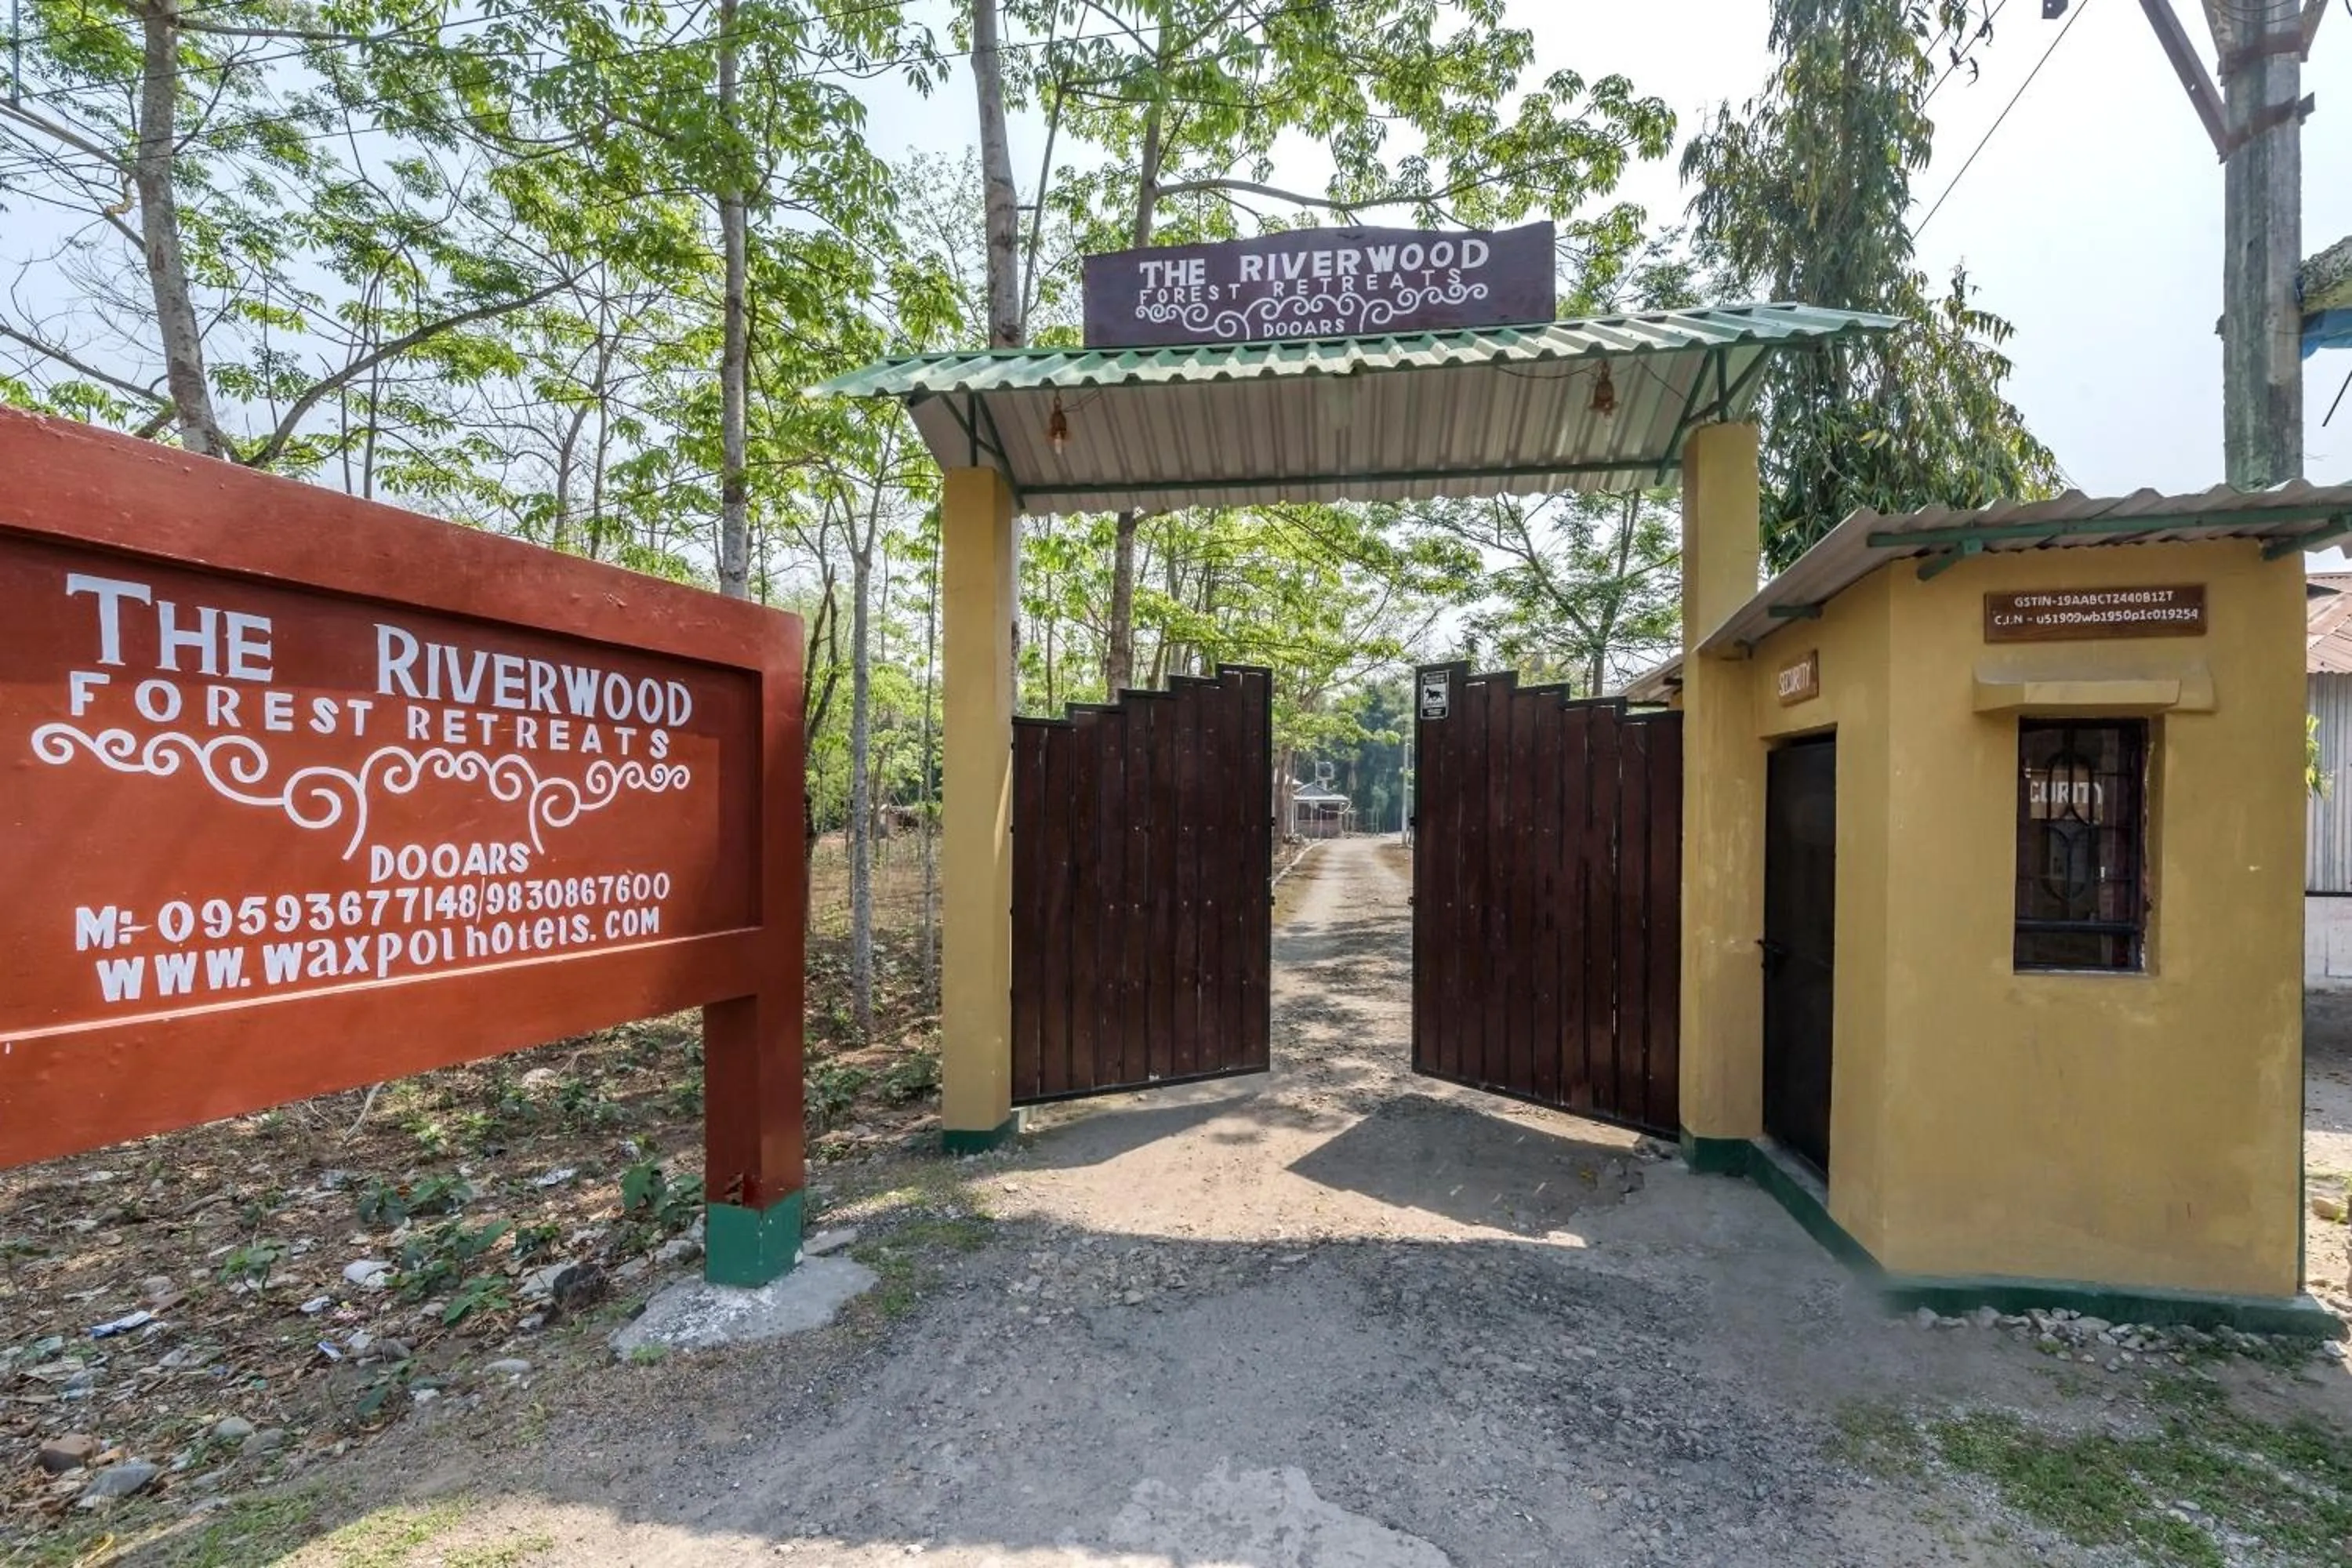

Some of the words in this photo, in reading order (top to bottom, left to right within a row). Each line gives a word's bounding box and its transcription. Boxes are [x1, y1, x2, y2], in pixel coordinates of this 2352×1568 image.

[1139, 258, 1206, 289] THE
[1240, 239, 1489, 282] RIVERWOOD
[1139, 283, 1241, 304] FOREST
[1273, 268, 1461, 297] RETREATS
[1263, 318, 1345, 338] DOOARS
[66, 573, 273, 682] THE
[373, 623, 692, 727] RIVERWOOD
[69, 671, 373, 736] FOREST
[407, 705, 670, 759] RETREATS
[370, 842, 530, 883] DOOARS
